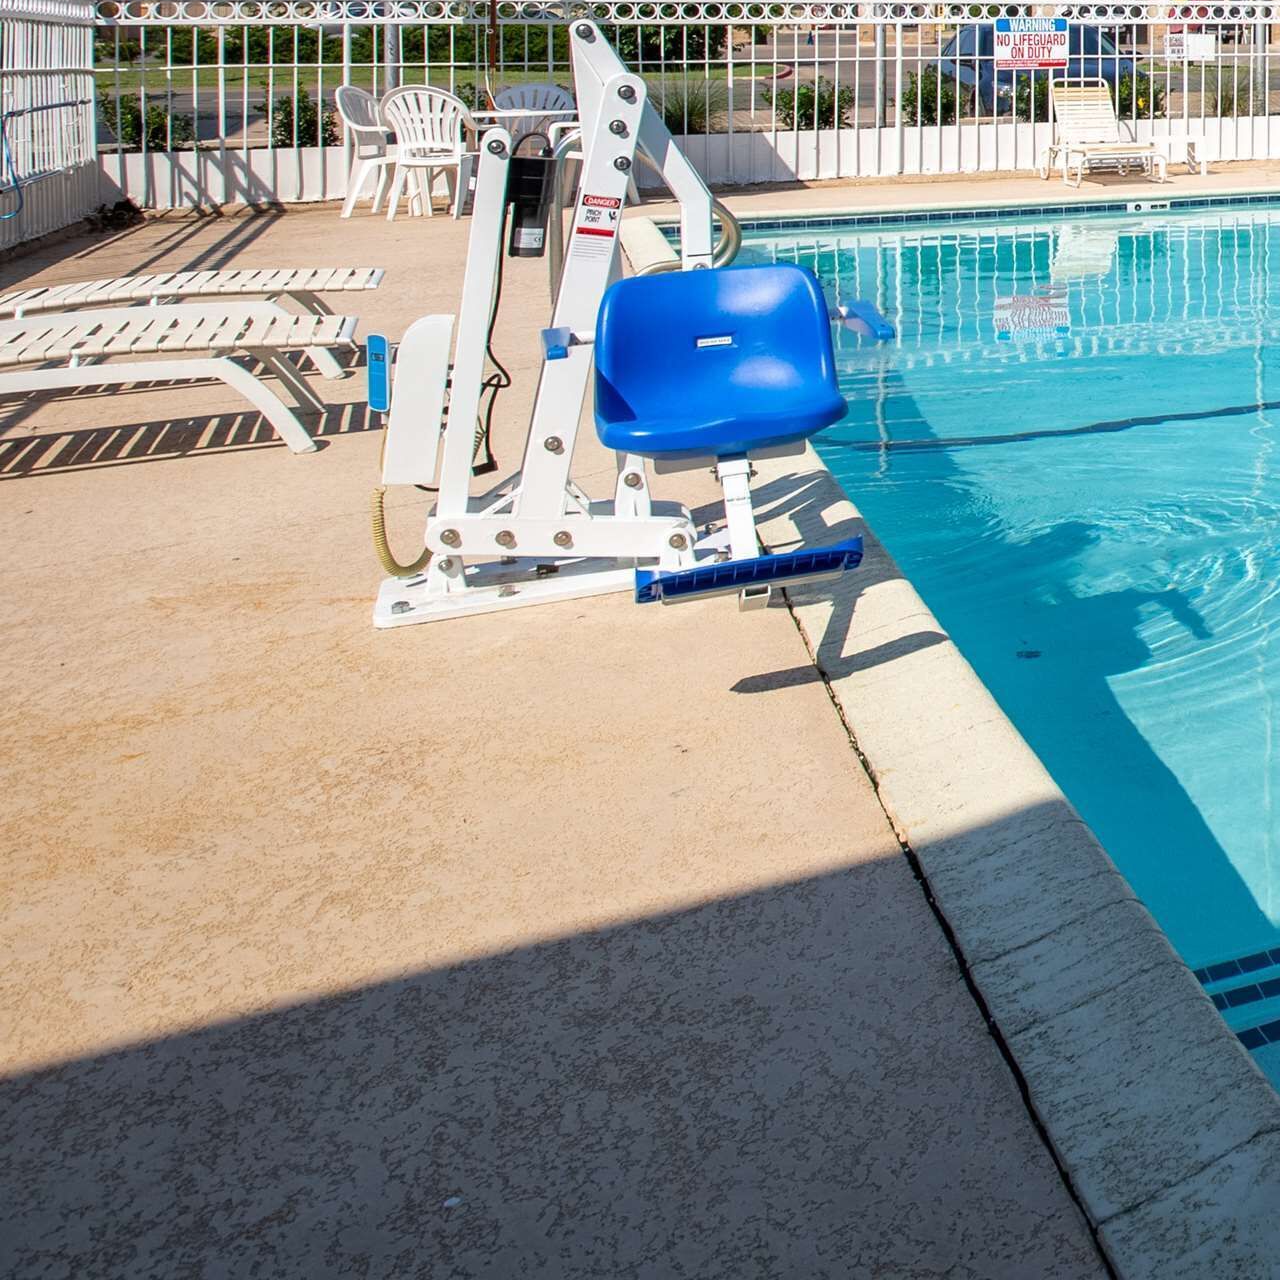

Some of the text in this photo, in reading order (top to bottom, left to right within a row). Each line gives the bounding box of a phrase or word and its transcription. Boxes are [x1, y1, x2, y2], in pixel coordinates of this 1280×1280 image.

[1009, 19, 1055, 32] WARNING
[997, 34, 1066, 47] NO LIFEGUARD
[1011, 46, 1052, 58] ON DUTY
[588, 197, 616, 207] DANGER
